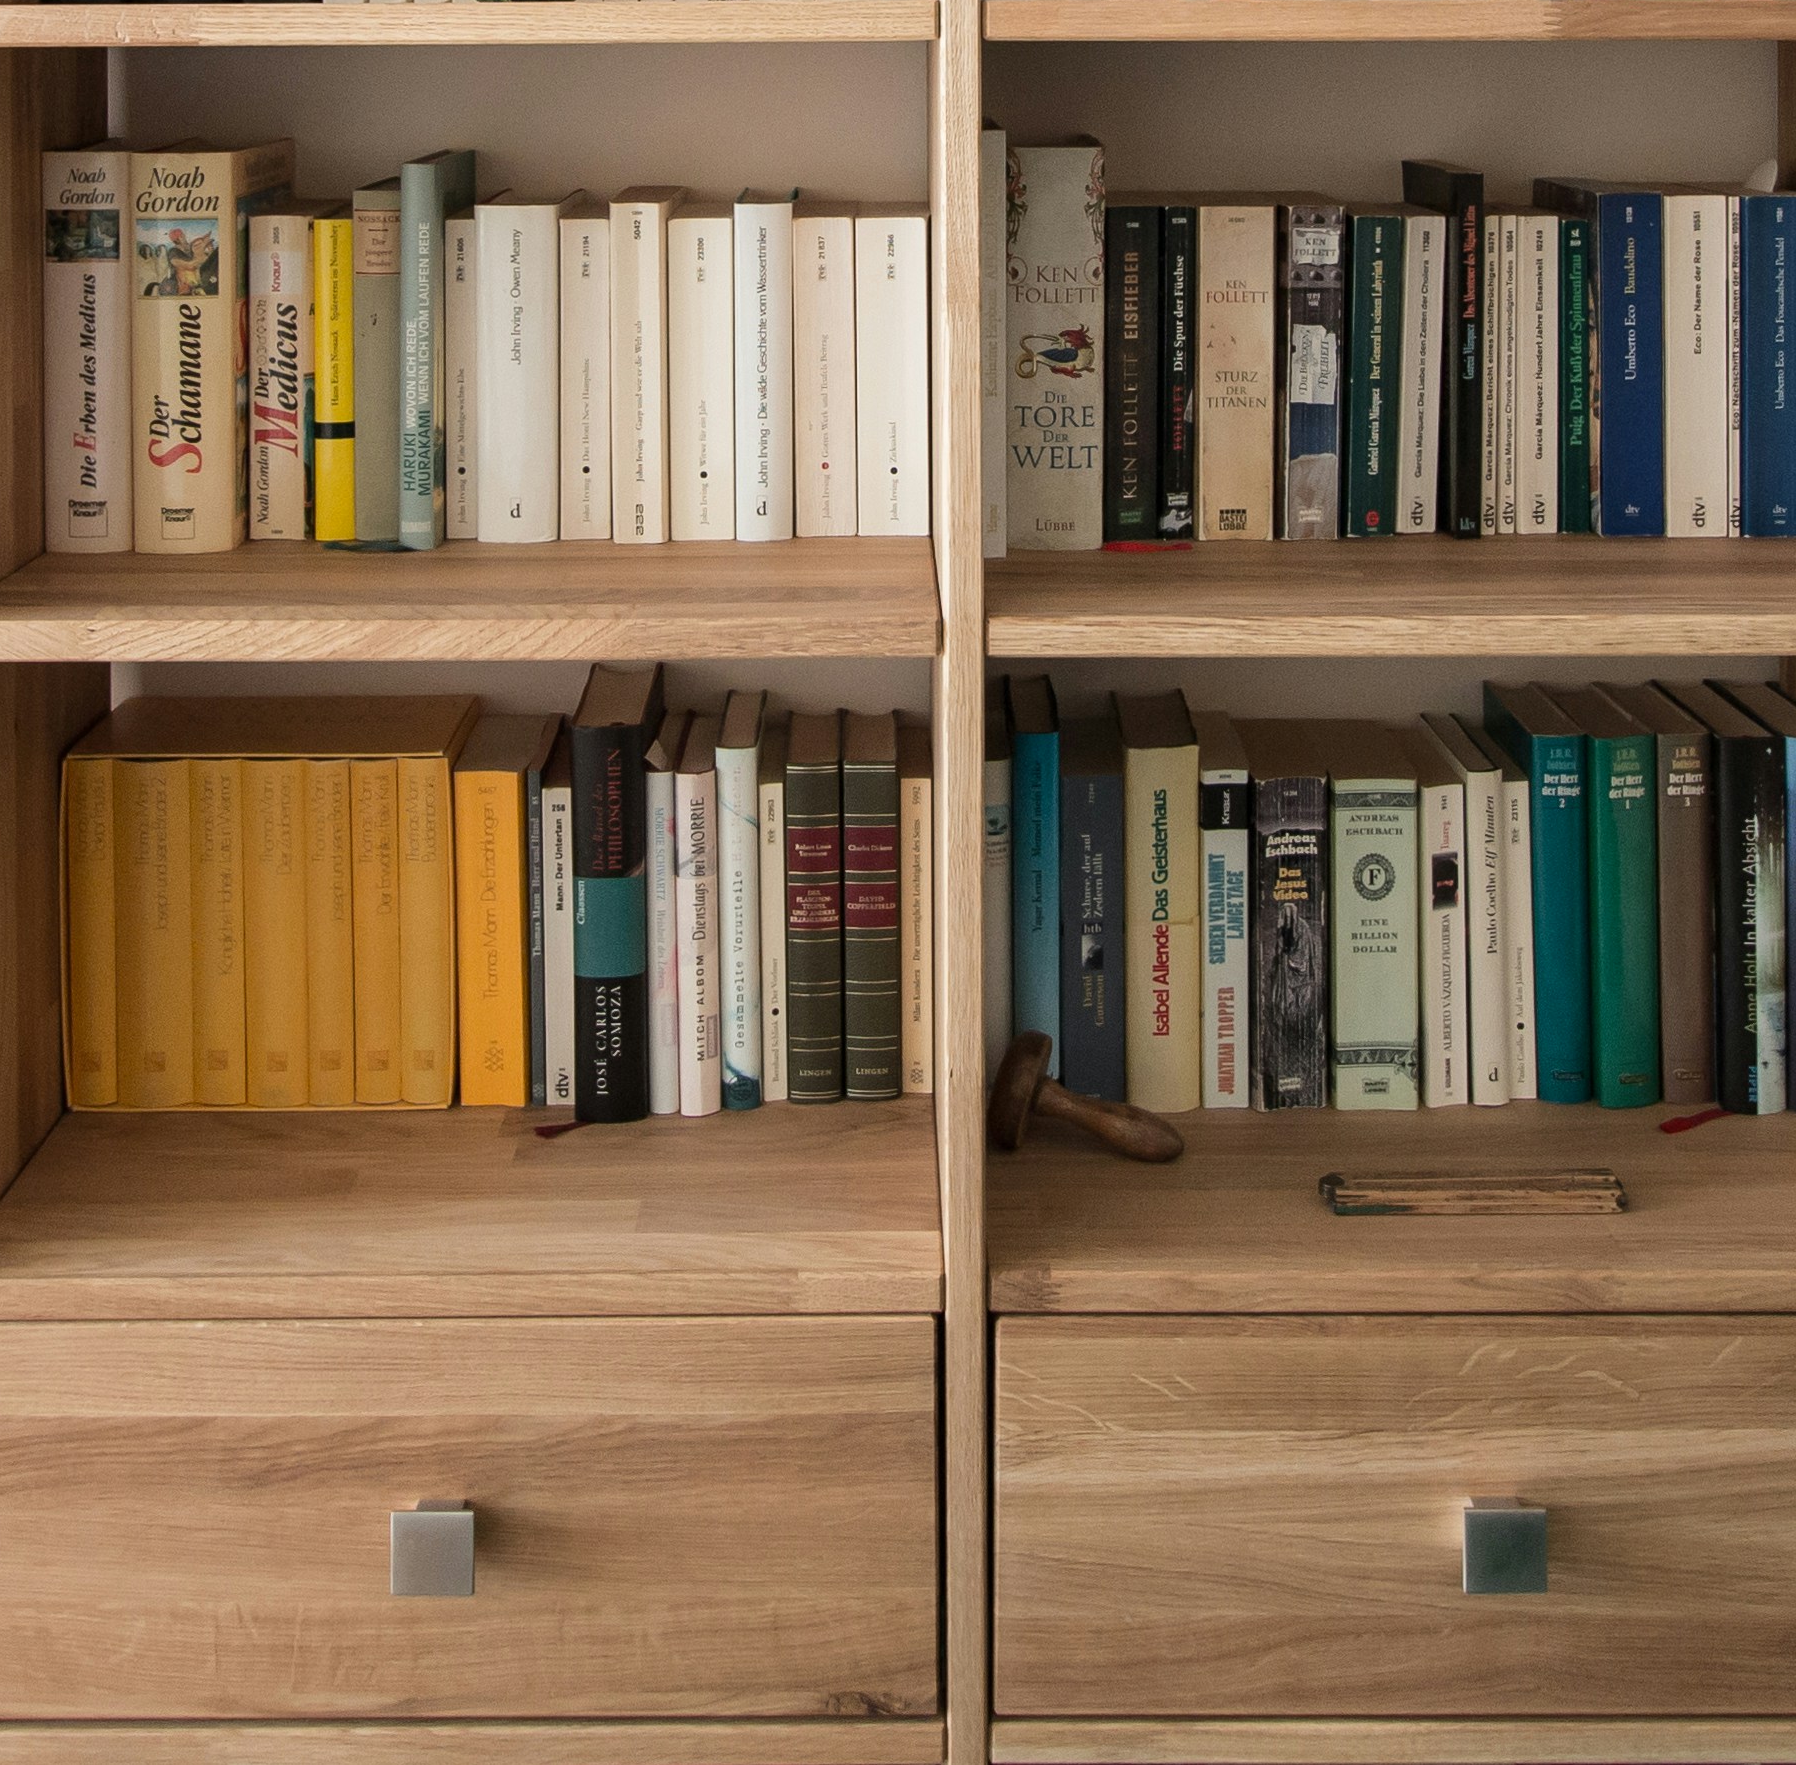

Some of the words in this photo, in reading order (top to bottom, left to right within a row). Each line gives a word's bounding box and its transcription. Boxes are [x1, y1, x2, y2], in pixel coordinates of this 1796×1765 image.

[147, 166, 205, 191] Noah
[135, 191, 220, 213] Gordon
[418, 222, 430, 255] REDE
[510, 229, 523, 264] Meany
[418, 258, 430, 306] LAUFEN
[510, 267, 522, 298] Owen
[1624, 237, 1636, 294] Baudolino
[79, 274, 97, 351] Medicus
[1123, 252, 1139, 339] EISFIEBER
[1624, 304, 1637, 326] Eco
[405, 318, 418, 353] REDE,
[418, 310, 430, 338] VOM
[510, 306, 523, 335] Irving
[81, 356, 97, 386] des
[405, 356, 417, 378] ICH
[418, 341, 430, 362] ICH
[510, 339, 522, 365] John
[1625, 329, 1637, 380] Umberto
[148, 304, 204, 474] Schamane
[405, 381, 417, 427] WOVON
[418, 365, 430, 404] WENN
[1122, 355, 1138, 446] FOLLETT
[73, 390, 97, 452] Erben
[149, 395, 170, 439] Der
[1014, 406, 1096, 427] TORE
[80, 455, 97, 488] Die
[403, 433, 416, 491] HARUKI
[418, 410, 431, 496] MURAKAMI
[1012, 445, 1099, 469] WELT
[1122, 457, 1137, 498] KEN
[690, 797, 705, 854] MORRIE
[1151, 789, 1169, 884] Geisterhaus
[1742, 817, 1757, 875] Absicht
[689, 859, 705, 877] bei
[691, 883, 709, 941] Dienstags
[1152, 889, 1169, 921] Das
[1742, 880, 1757, 925] kalter
[1152, 924, 1170, 985] Allende
[1743, 931, 1757, 945] In
[696, 955, 705, 1005] ALBOM
[1742, 952, 1757, 986] Holt
[595, 985, 607, 1051] CARLOS
[608, 985, 622, 1057] SOMOZA
[1152, 989, 1170, 1037] Isabel
[1218, 987, 1235, 1038] TROPPER
[1743, 993, 1757, 1033] Anne
[696, 1014, 705, 1061] MITCH
[593, 1058, 609, 1095] JOSÉ
[1218, 1043, 1235, 1095] JONATHAN
